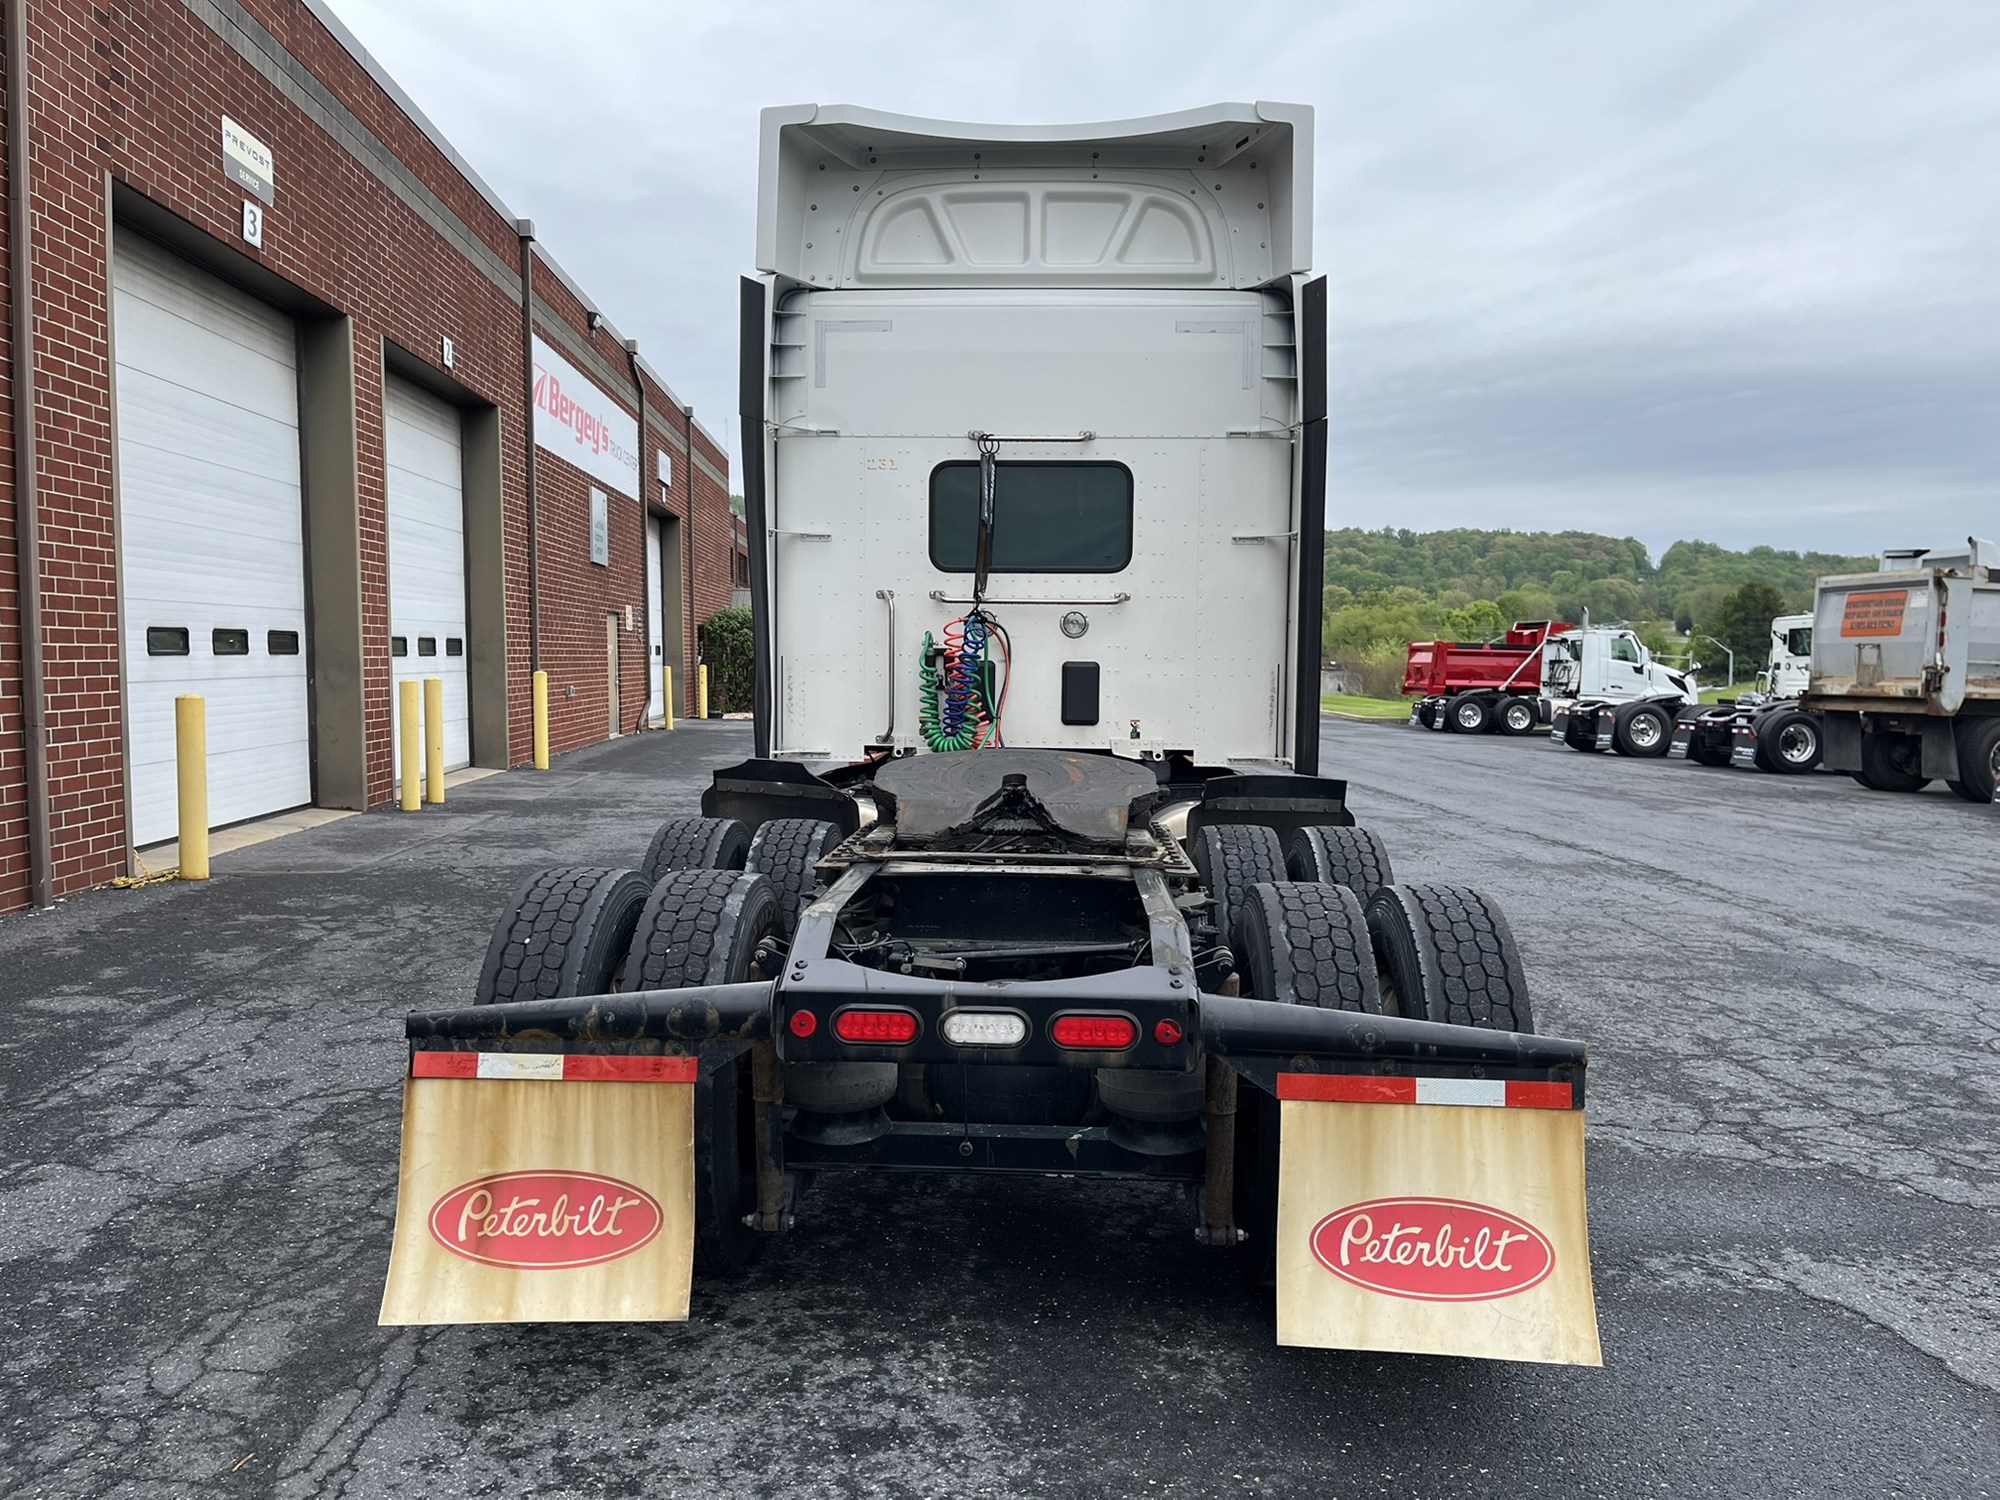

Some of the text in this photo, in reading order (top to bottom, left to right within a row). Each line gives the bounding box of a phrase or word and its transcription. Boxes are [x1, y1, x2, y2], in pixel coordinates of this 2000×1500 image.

[225, 129, 270, 170] PREVOST
[239, 168, 260, 191] SERVICE
[247, 209, 258, 237] 3
[445, 341, 450, 363] 2
[549, 375, 608, 455] Bergey's
[457, 1189, 641, 1242] Peterbilt
[1340, 1213, 1529, 1272] Peterbilt
